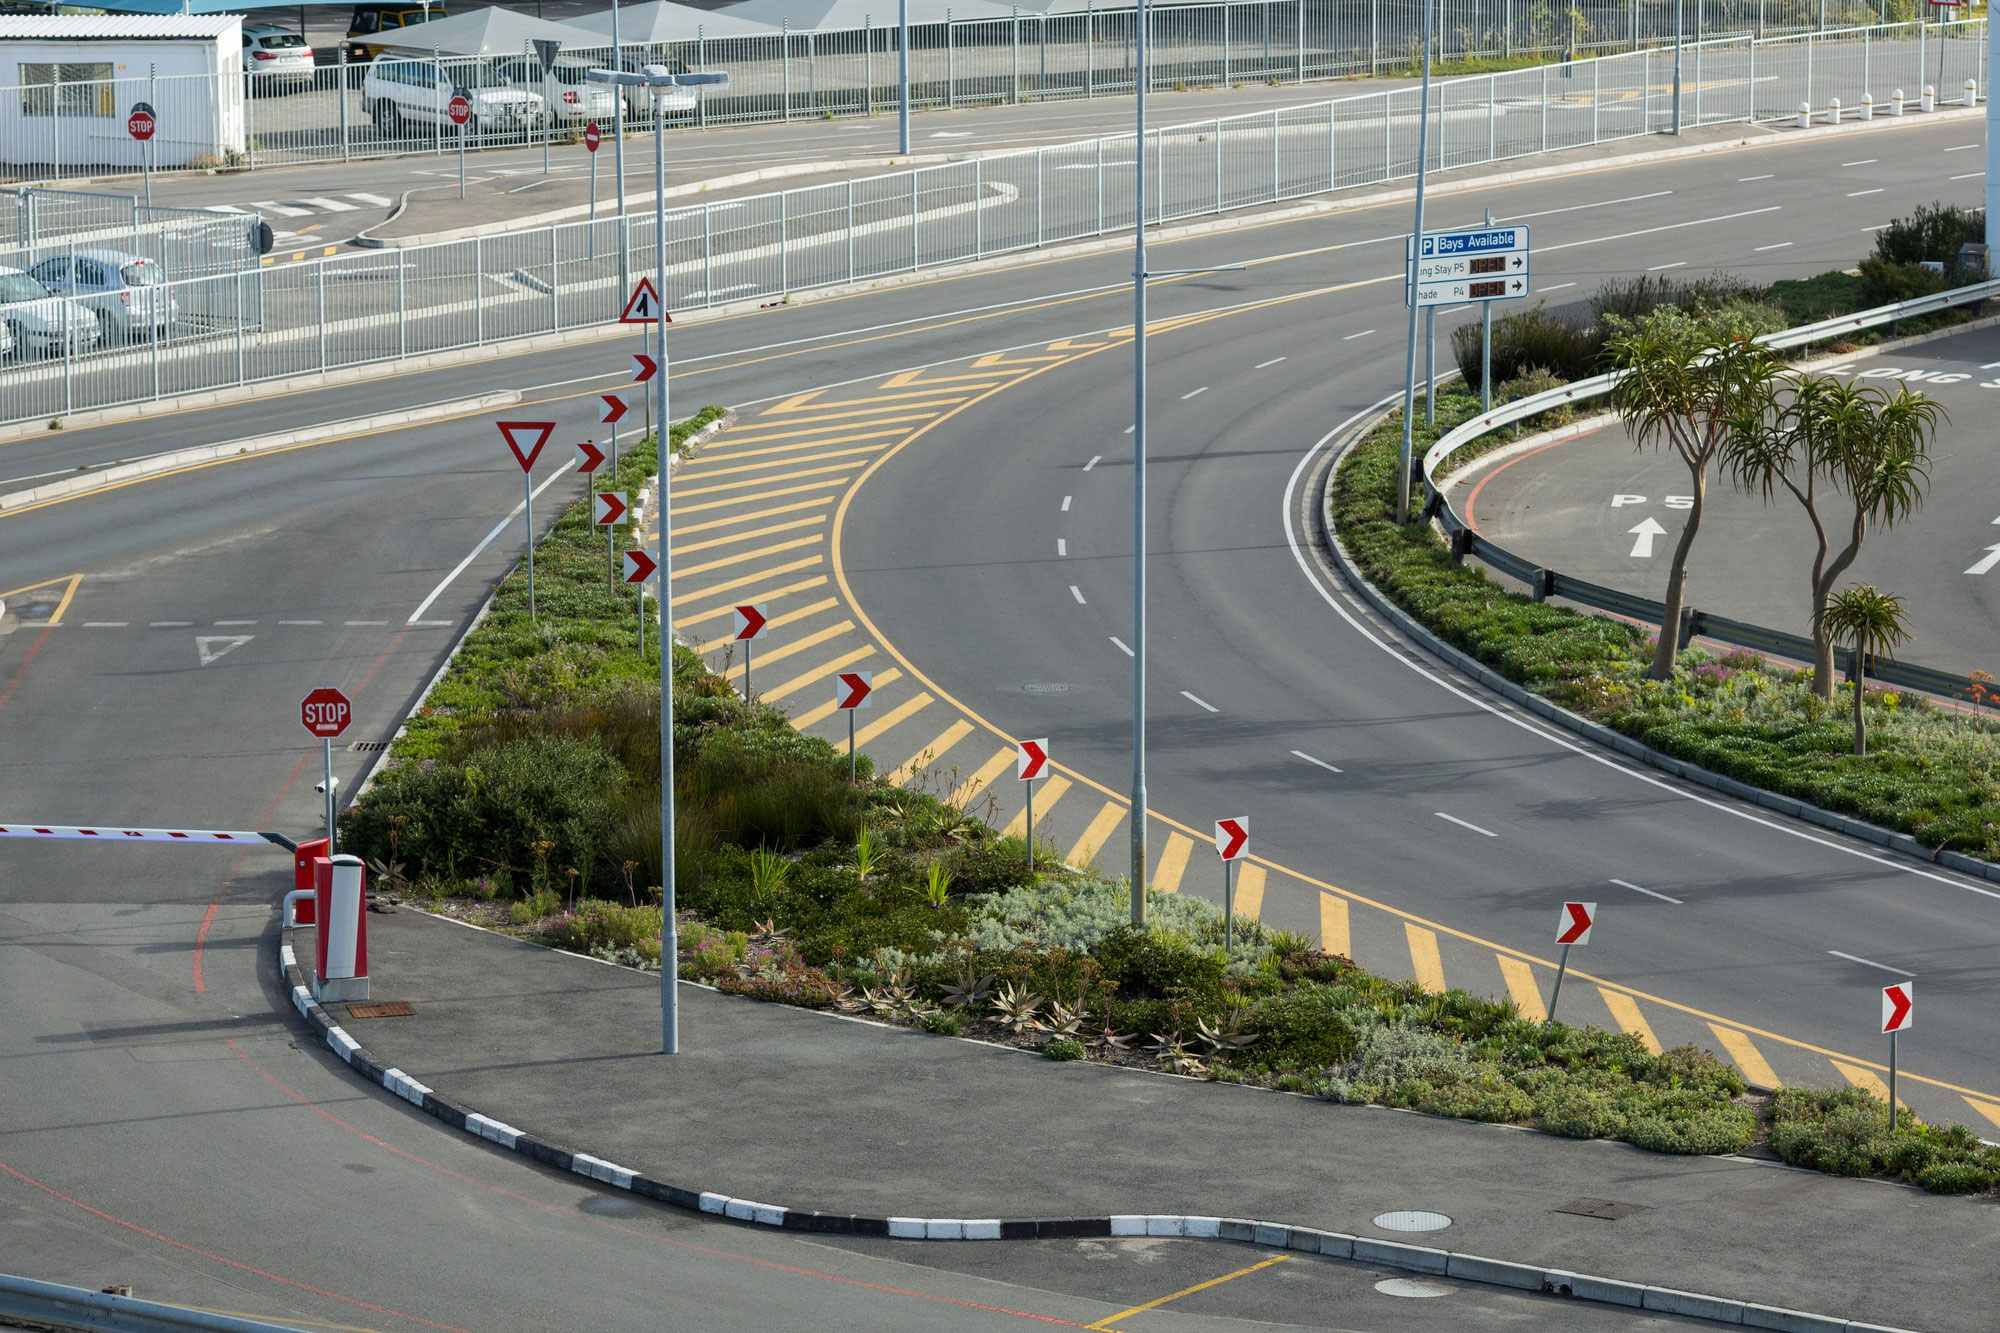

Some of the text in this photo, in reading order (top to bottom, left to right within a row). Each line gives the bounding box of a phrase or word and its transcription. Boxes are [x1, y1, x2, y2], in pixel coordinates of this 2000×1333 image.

[450, 104, 468, 116] STOP
[130, 120, 153, 132] STOP
[1423, 232, 1514, 253] P Bays Available
[1419, 263, 1464, 278] ong Stay P5
[1470, 257, 1505, 274] OPEN
[1418, 286, 1464, 299] hade P4
[1470, 281, 1505, 298] OPEN
[1819, 364, 1972, 384] LONG
[1611, 494, 1695, 509] P 5
[305, 703, 348, 724] STOP
